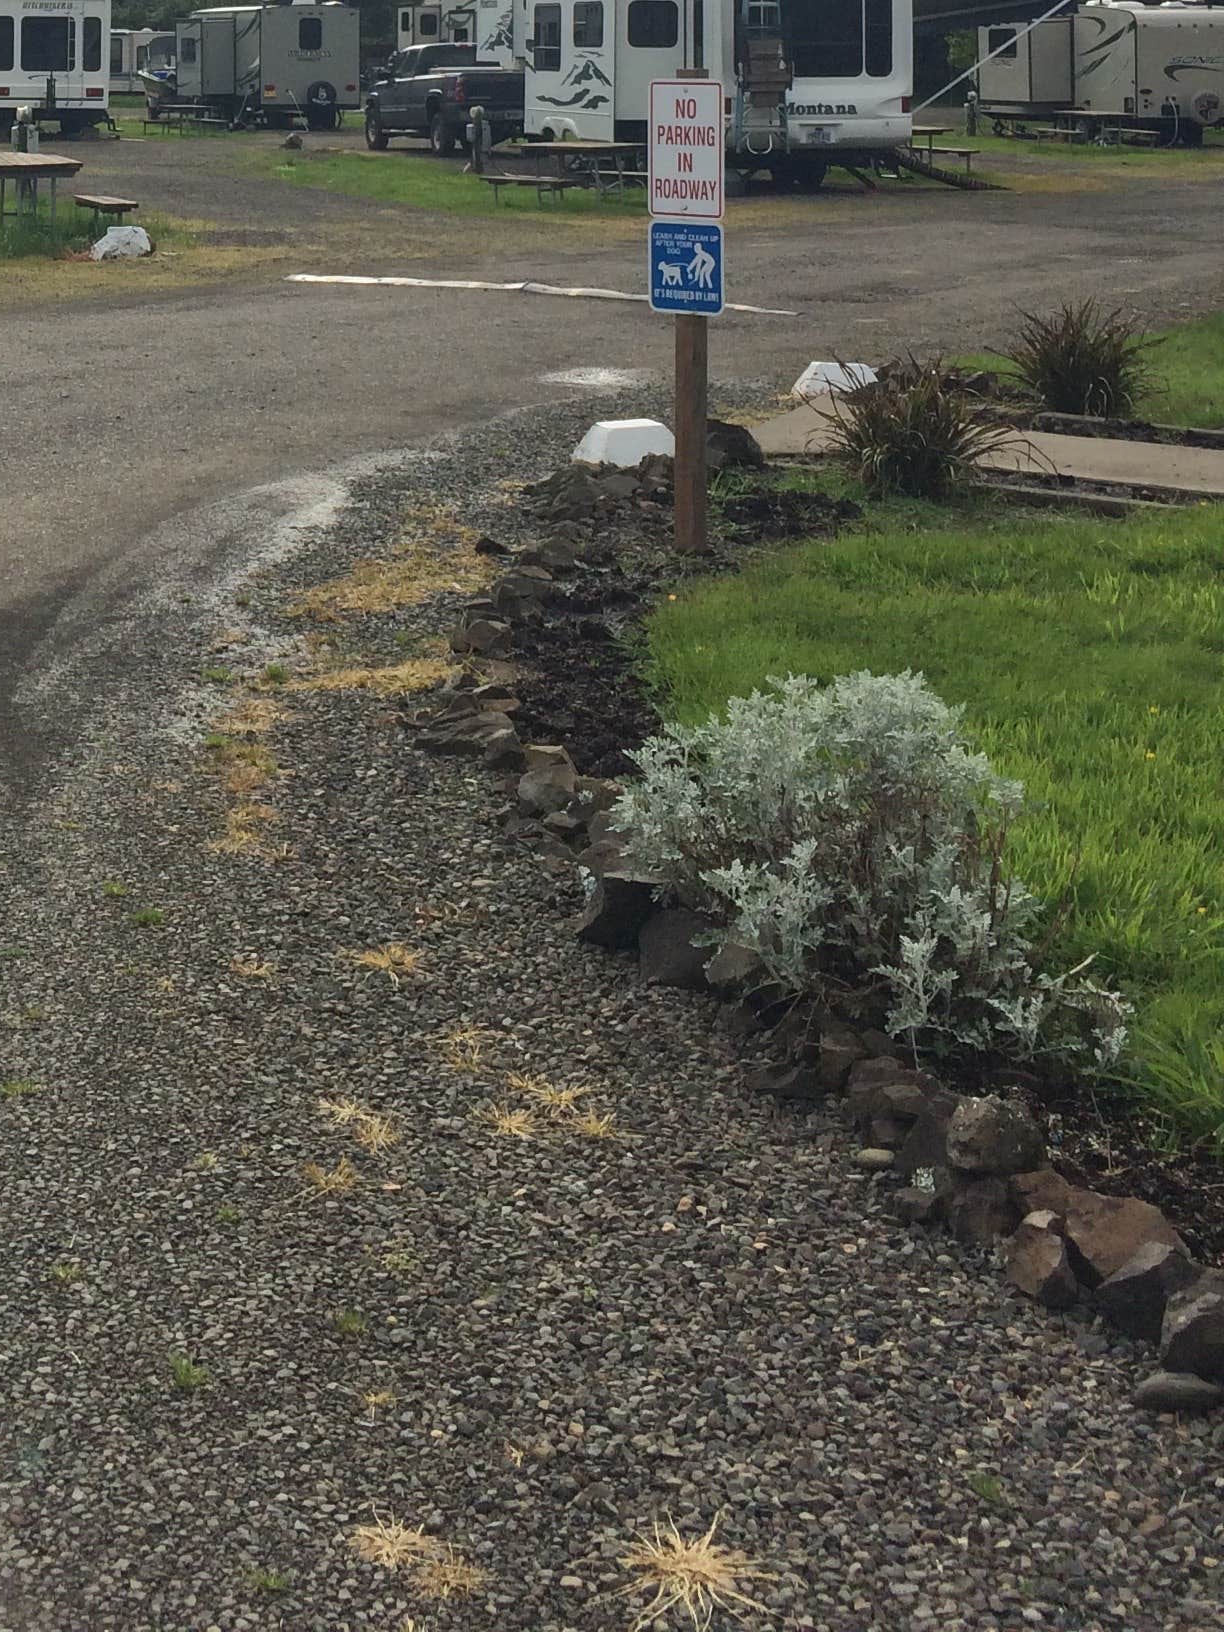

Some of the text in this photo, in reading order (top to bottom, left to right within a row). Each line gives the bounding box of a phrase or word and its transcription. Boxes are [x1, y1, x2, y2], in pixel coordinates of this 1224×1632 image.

[676, 98, 697, 119] NO
[657, 125, 716, 146] PARKING
[678, 152, 693, 173] IN
[655, 179, 717, 200] ROADWAY
[653, 232, 672, 240] LEASH
[674, 233, 687, 241] AND
[688, 234, 709, 242] CLEAN
[666, 247, 681, 255] DOG
[665, 289, 695, 300] REQUIRED
[695, 291, 703, 301] BY
